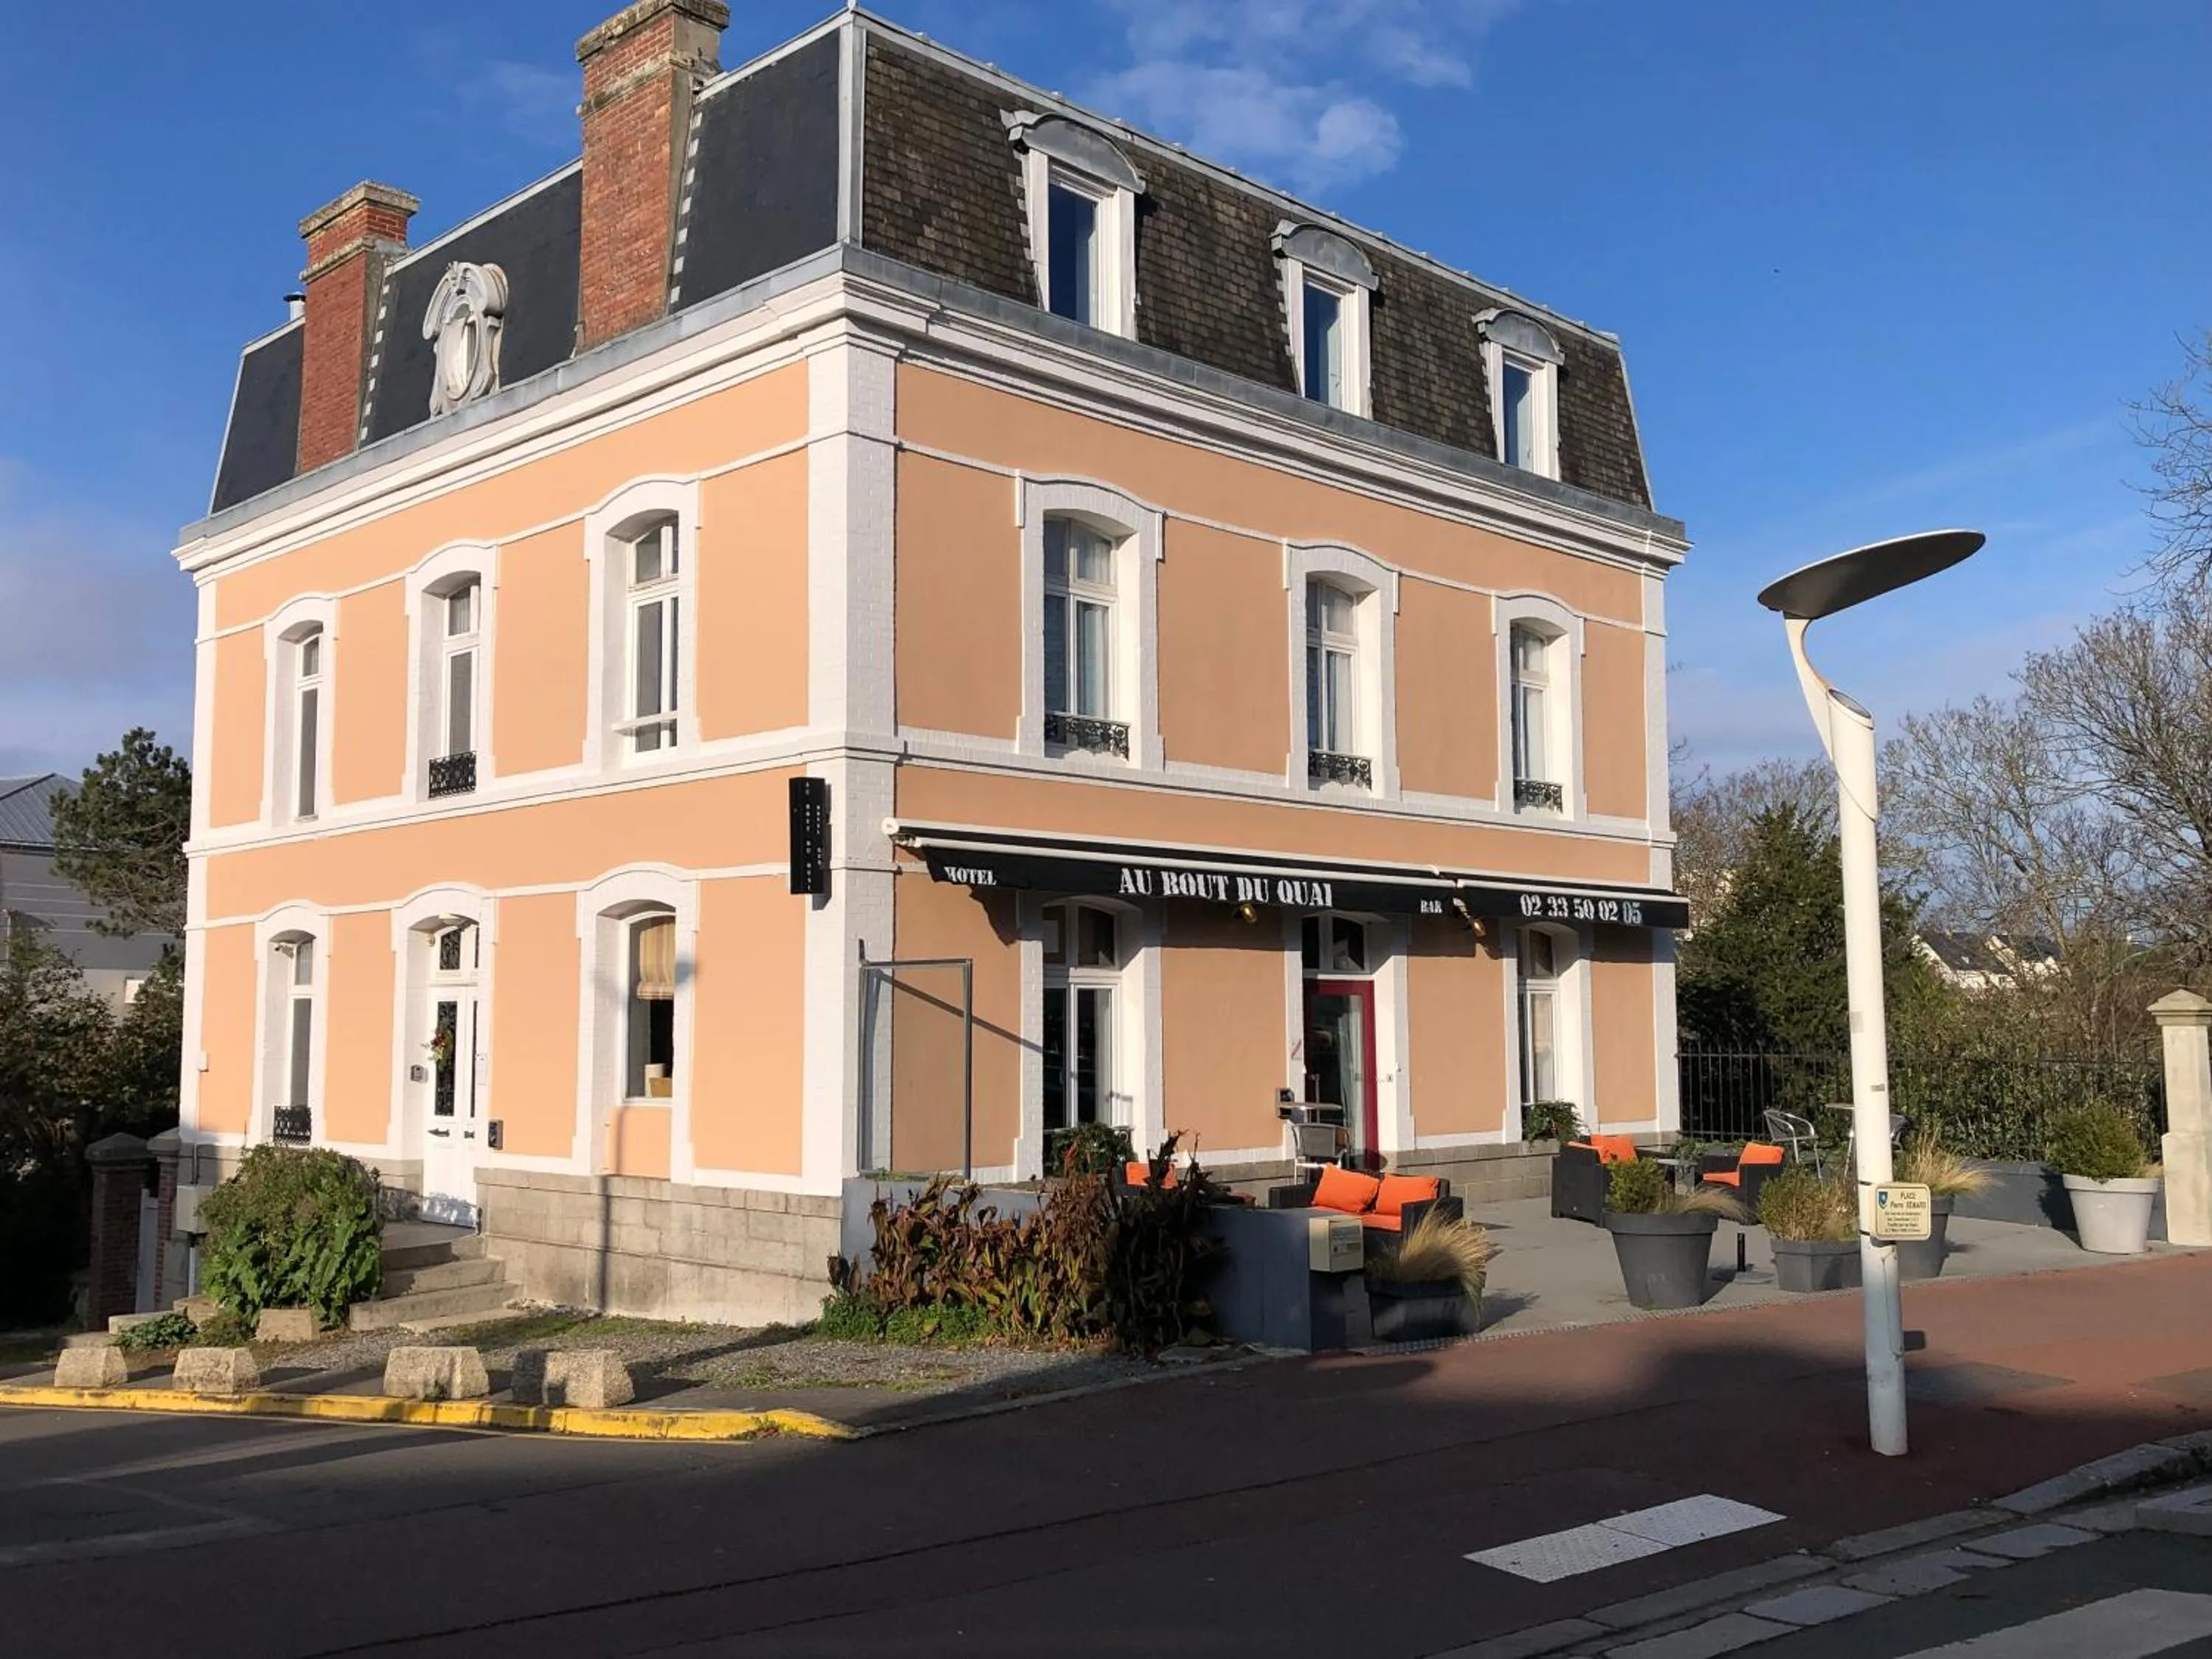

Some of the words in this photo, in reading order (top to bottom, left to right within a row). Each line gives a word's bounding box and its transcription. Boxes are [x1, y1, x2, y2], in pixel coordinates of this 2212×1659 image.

[944, 866, 997, 885] HOTEL
[1119, 868, 1152, 895] AU
[1160, 871, 1229, 900] BOUT
[1236, 877, 1268, 902] DU
[1277, 880, 1332, 907] QUAI
[1420, 900, 1442, 914] BAR
[1520, 894, 1543, 917] 02
[1548, 896, 1568, 917] 33
[1573, 898, 1594, 919] 50
[1598, 900, 1618, 921] 02
[1623, 901, 1642, 925] 05
